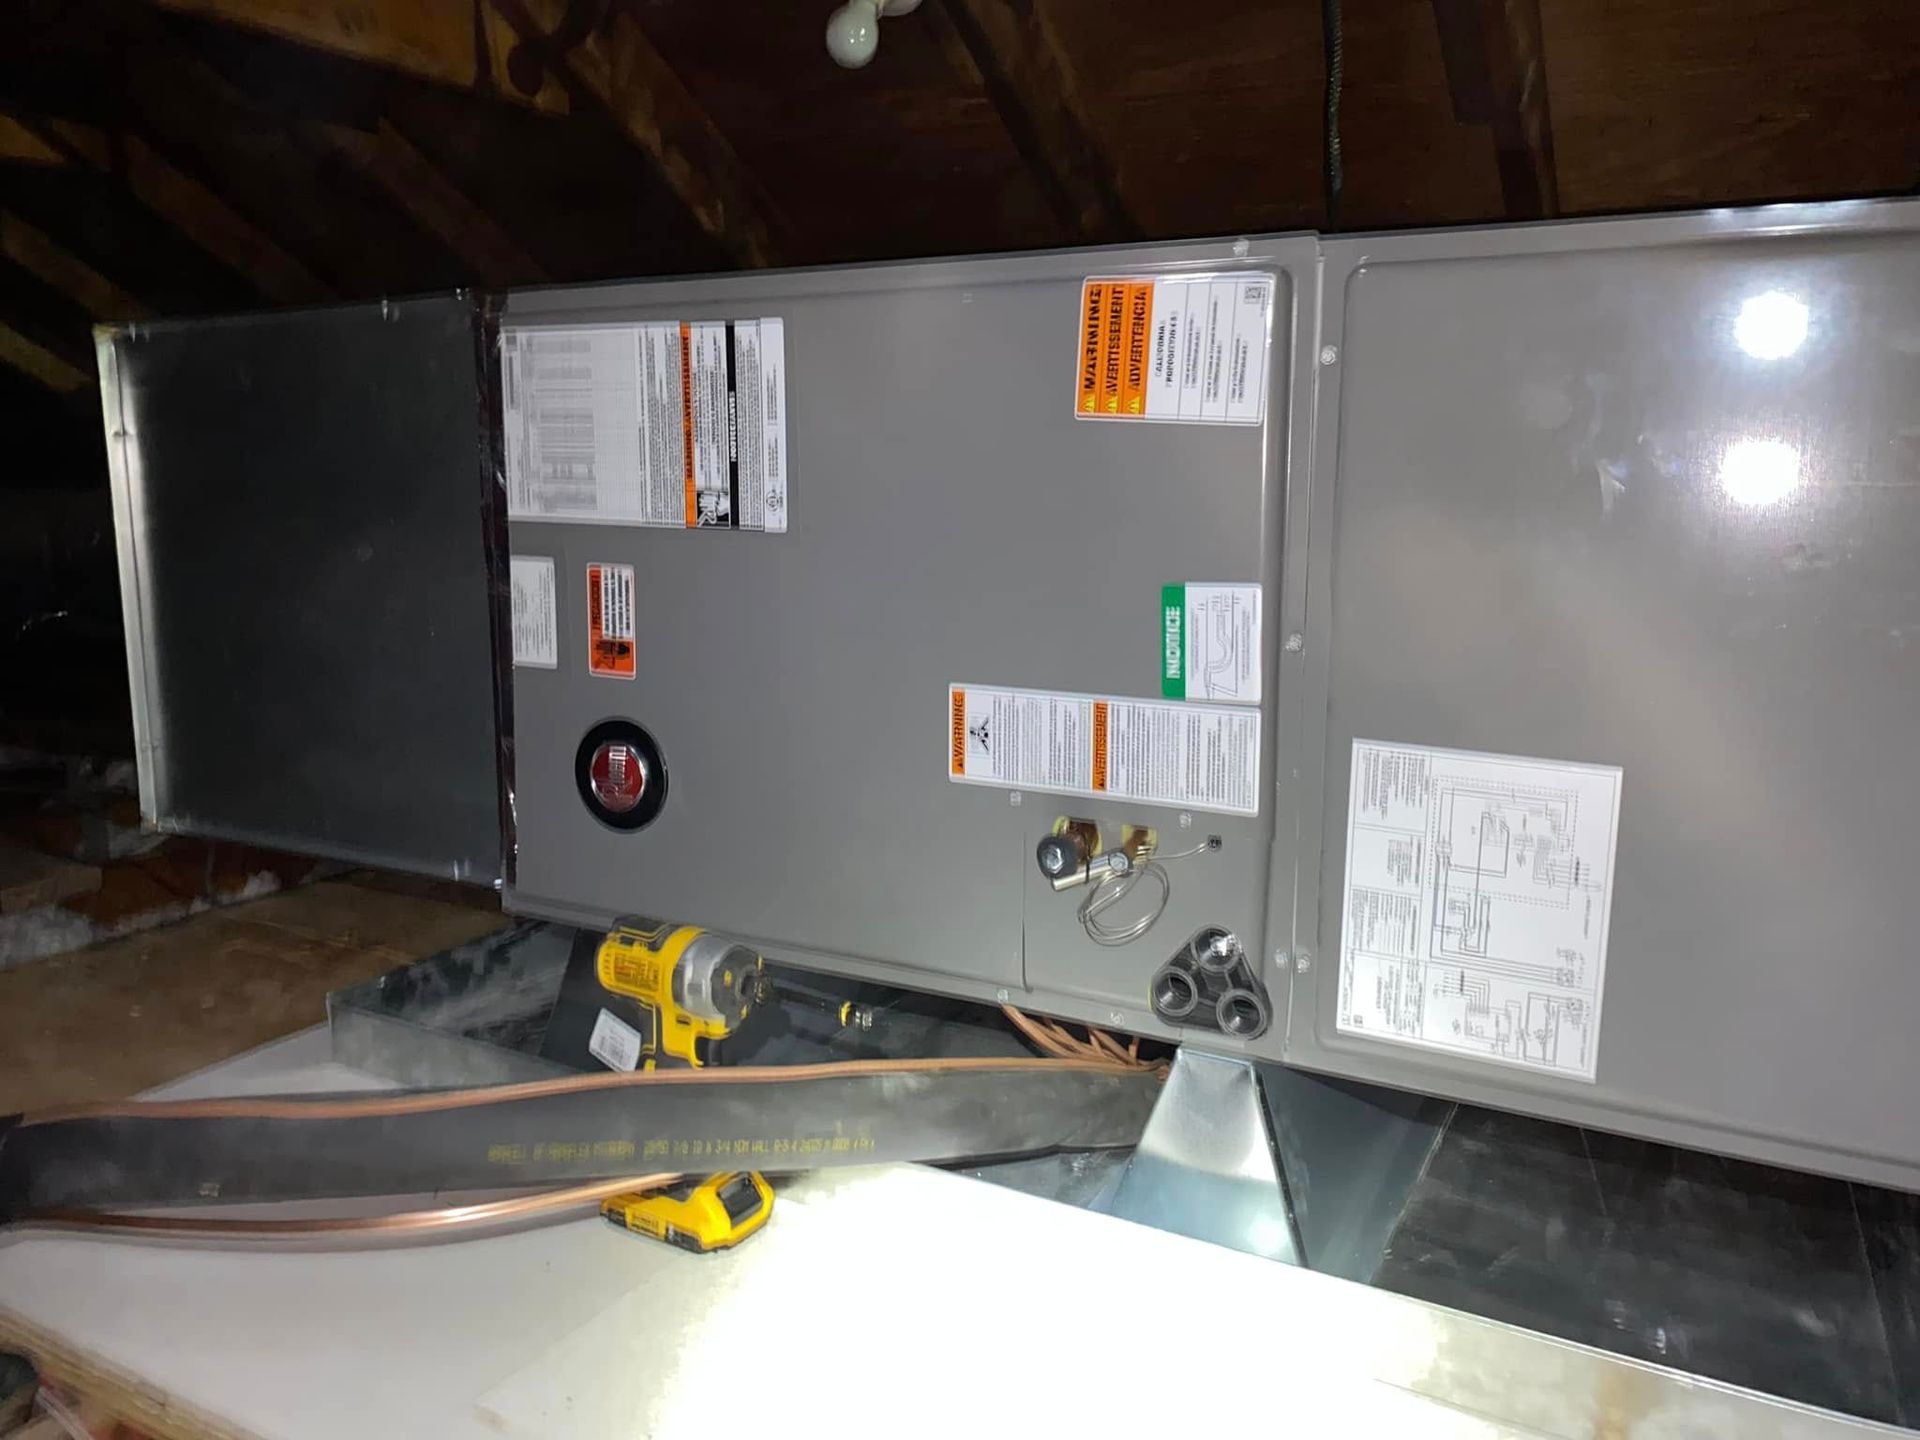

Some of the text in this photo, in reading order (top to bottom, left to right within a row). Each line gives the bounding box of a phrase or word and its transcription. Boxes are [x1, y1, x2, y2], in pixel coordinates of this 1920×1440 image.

[1084, 286, 1102, 391] WARNING
[1105, 286, 1124, 396] AVERTISSEMENT
[1128, 290, 1147, 389] ADVERTENCIA
[1165, 606, 1181, 679] NOTICE
[953, 697, 963, 758] WARNING
